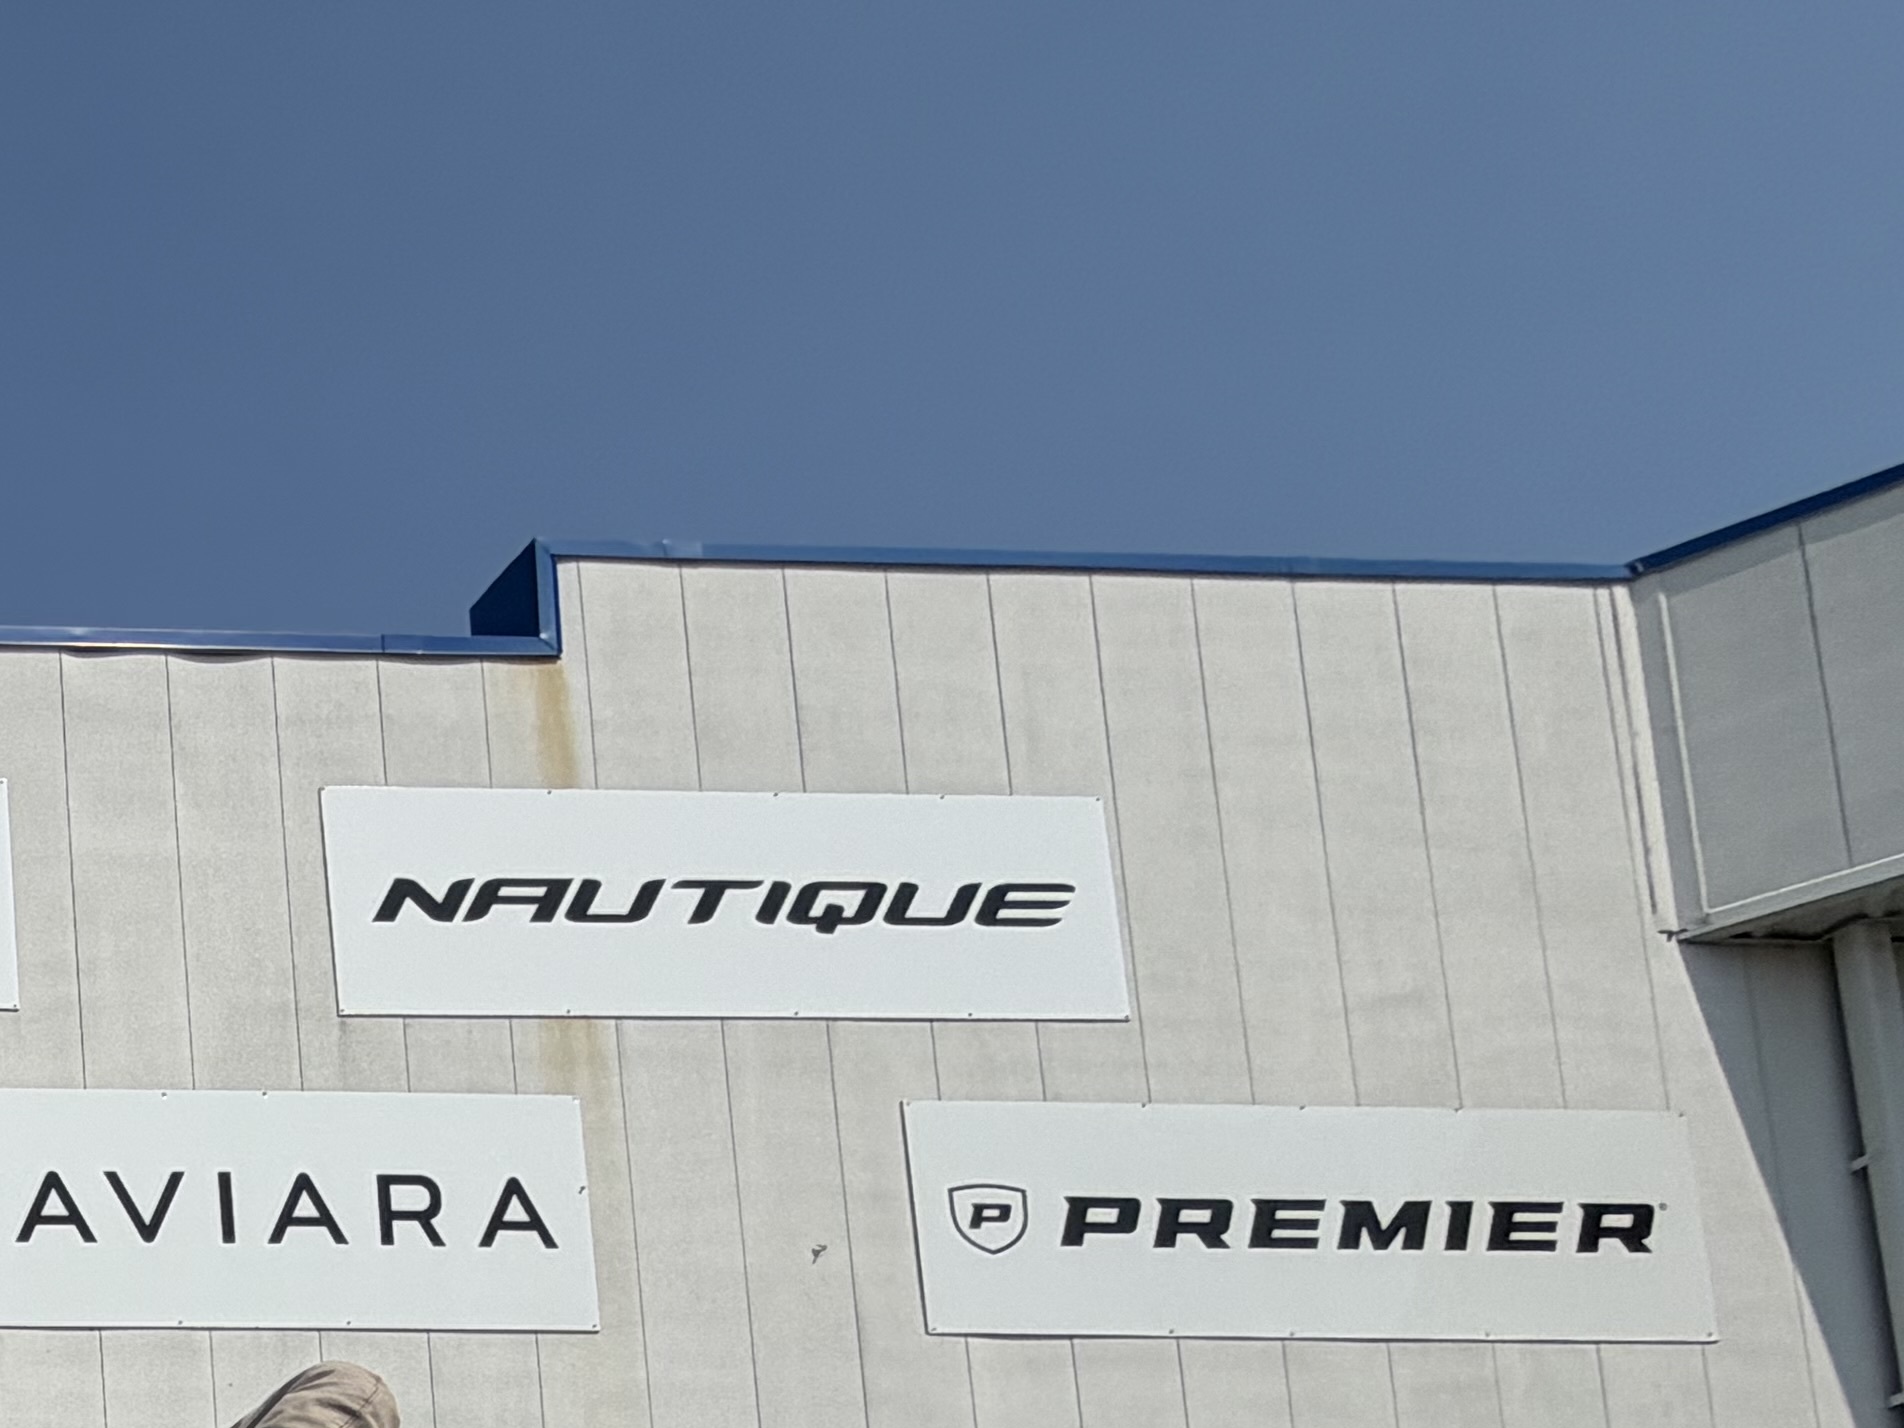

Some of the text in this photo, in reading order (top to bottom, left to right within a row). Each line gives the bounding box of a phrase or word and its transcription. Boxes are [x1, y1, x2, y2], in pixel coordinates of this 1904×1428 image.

[372, 878, 1076, 935] NAUTIQUE
[16, 1170, 559, 1249] AVIARA
[1060, 1196, 1655, 1254] PREMIER
